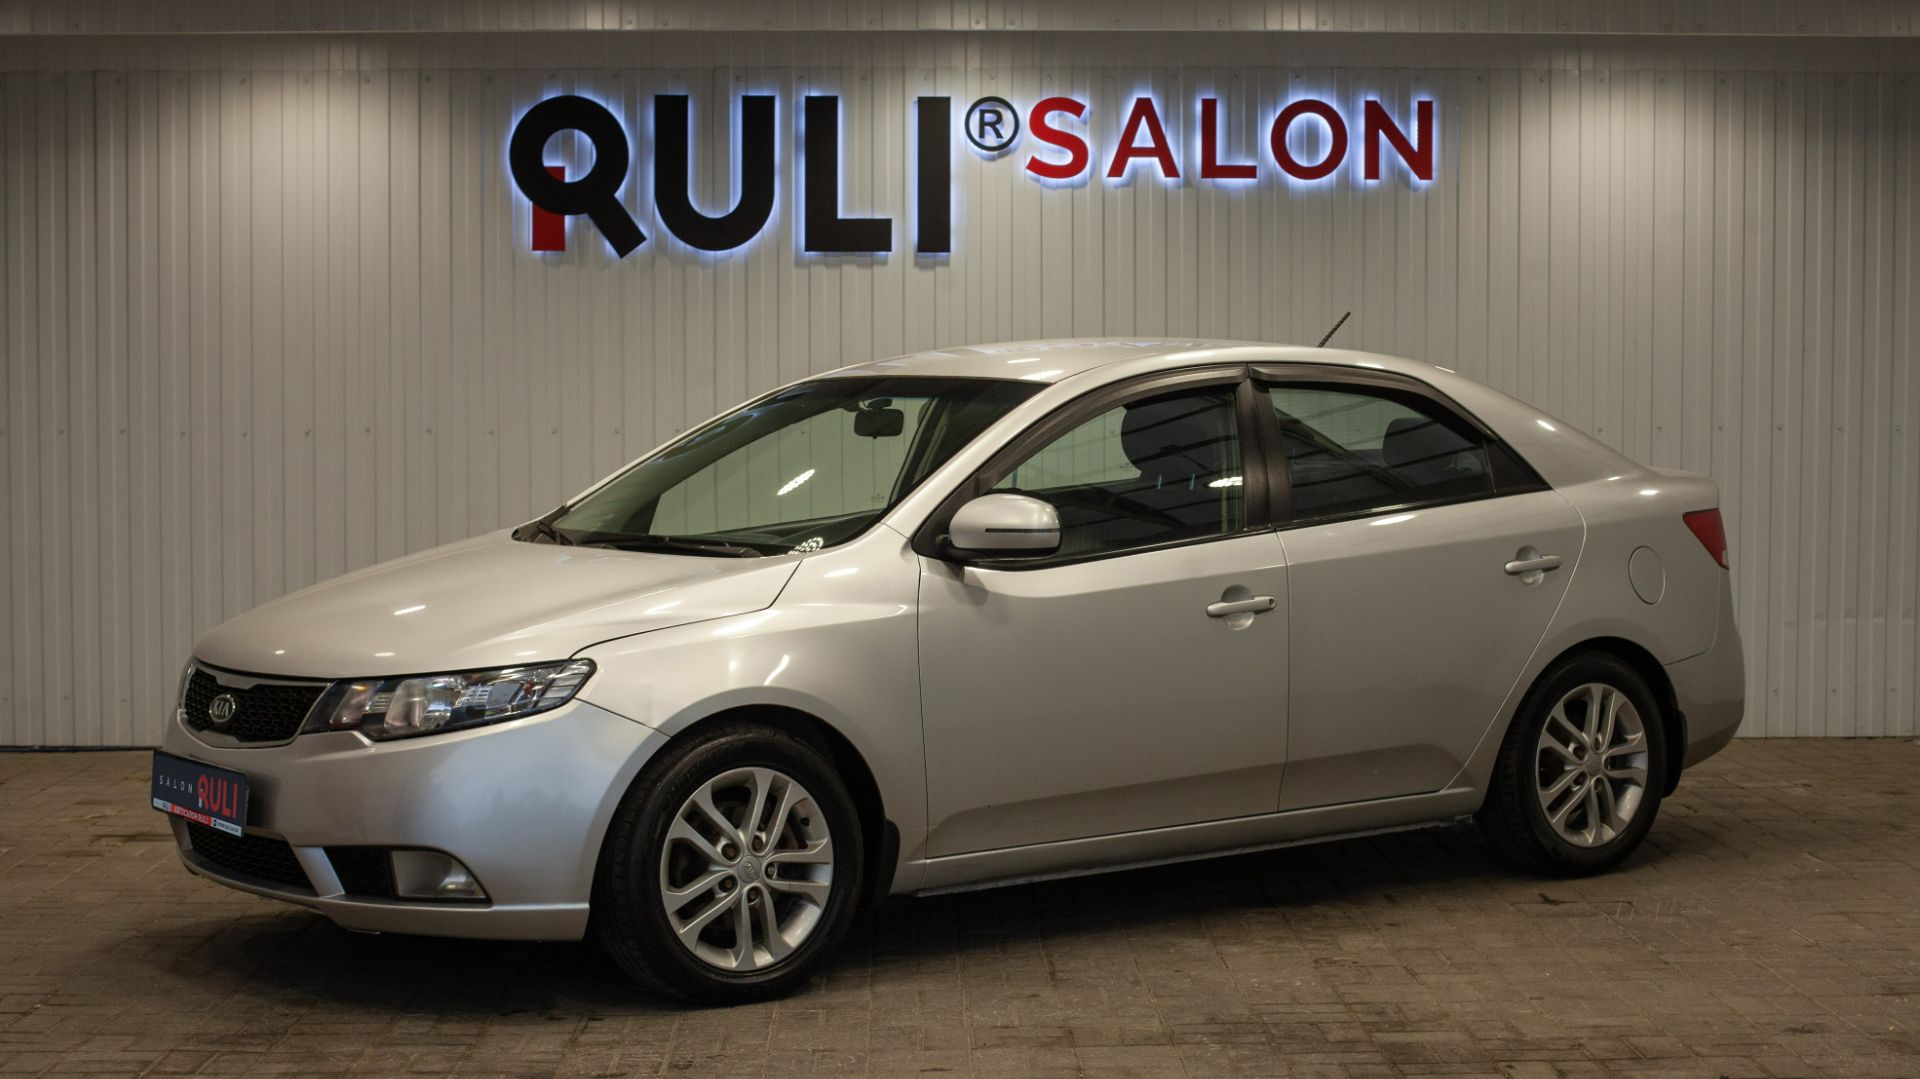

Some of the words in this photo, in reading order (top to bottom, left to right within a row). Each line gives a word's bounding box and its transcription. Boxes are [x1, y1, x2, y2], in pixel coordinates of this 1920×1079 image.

[1026, 96, 1433, 180] SALON
[213, 700, 230, 717] KIA
[159, 775, 193, 794] SALON
